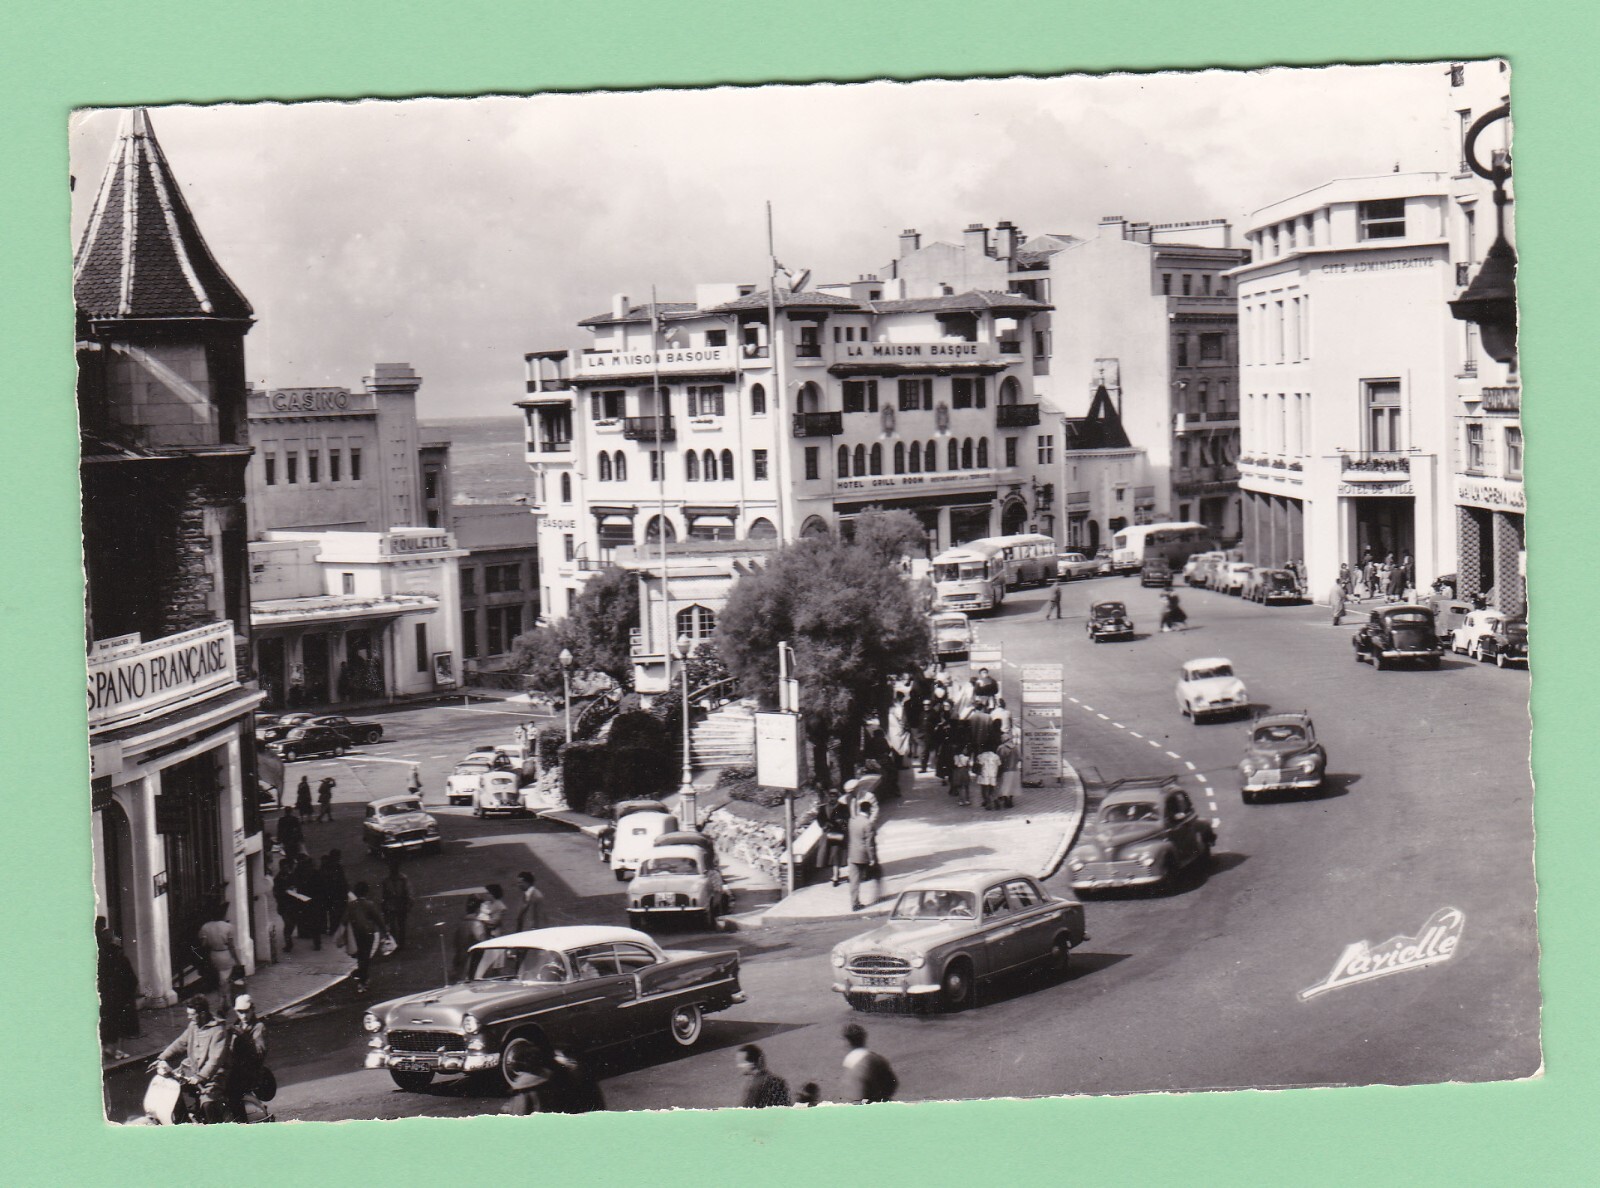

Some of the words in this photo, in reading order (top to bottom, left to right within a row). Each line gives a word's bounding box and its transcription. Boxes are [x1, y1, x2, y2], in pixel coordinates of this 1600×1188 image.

[1353, 256, 1434, 272] ADMINISTRATIVE
[589, 357, 605, 367] LA
[666, 350, 721, 363] BASQUE
[847, 346, 863, 357] LA
[873, 345, 922, 356] MAISON
[930, 345, 978, 358] BASQUE
[272, 391, 350, 411] CASINO
[837, 480, 865, 489] HOTEL
[872, 478, 896, 487] GRILL
[902, 476, 924, 485] ROOM
[1371, 483, 1384, 495] DE
[1388, 483, 1415, 495] VILLE
[543, 519, 576, 530] BASQUE
[390, 535, 450, 554] ROULETTE
[150, 637, 227, 694] FRANÇAISE
